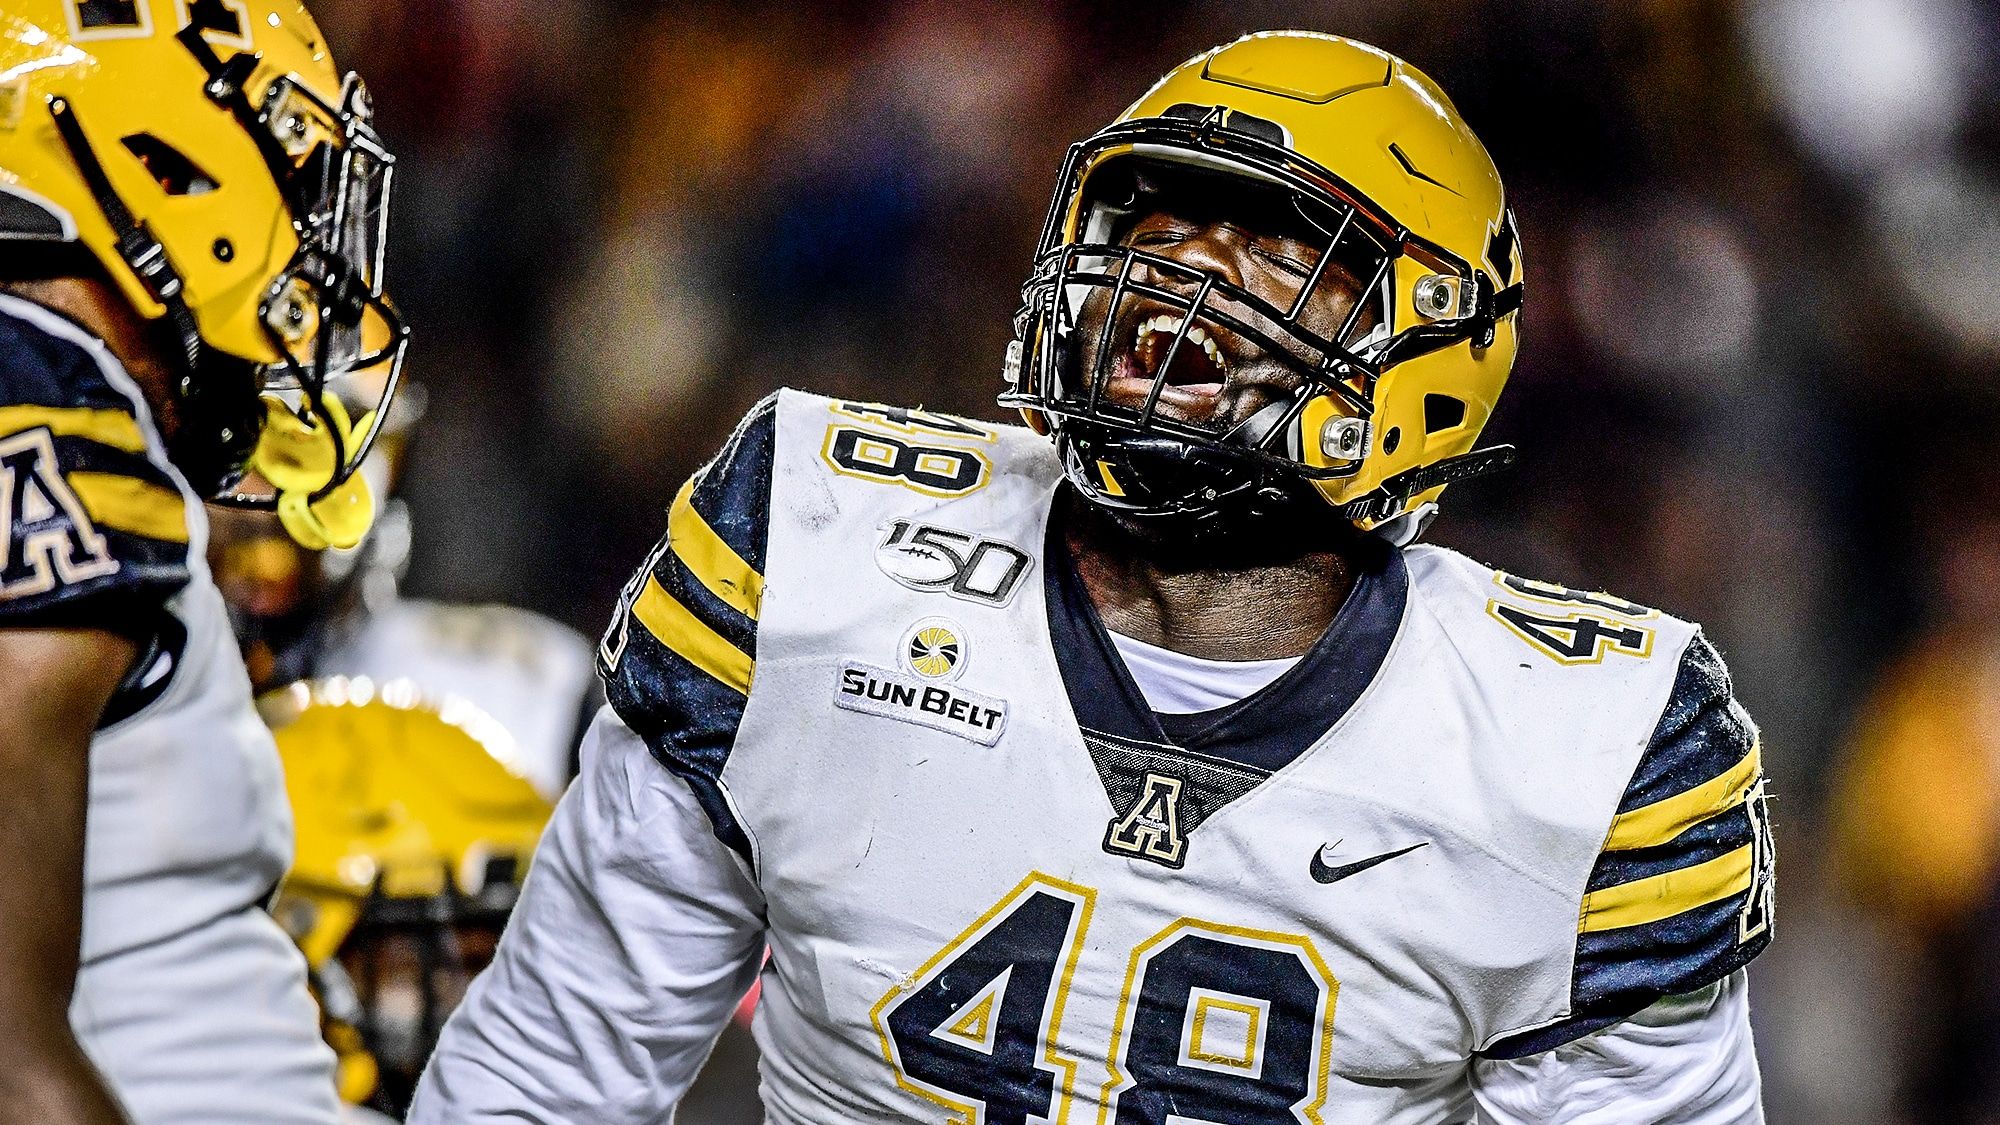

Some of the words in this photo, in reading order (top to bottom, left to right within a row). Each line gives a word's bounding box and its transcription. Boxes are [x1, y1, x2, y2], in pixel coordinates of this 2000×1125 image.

[0, 426, 120, 600] A
[880, 519, 1031, 604] 150
[842, 669, 917, 708] SUN
[920, 686, 1002, 730] BELT
[1107, 772, 1184, 864] A
[869, 870, 1340, 1125] 48
